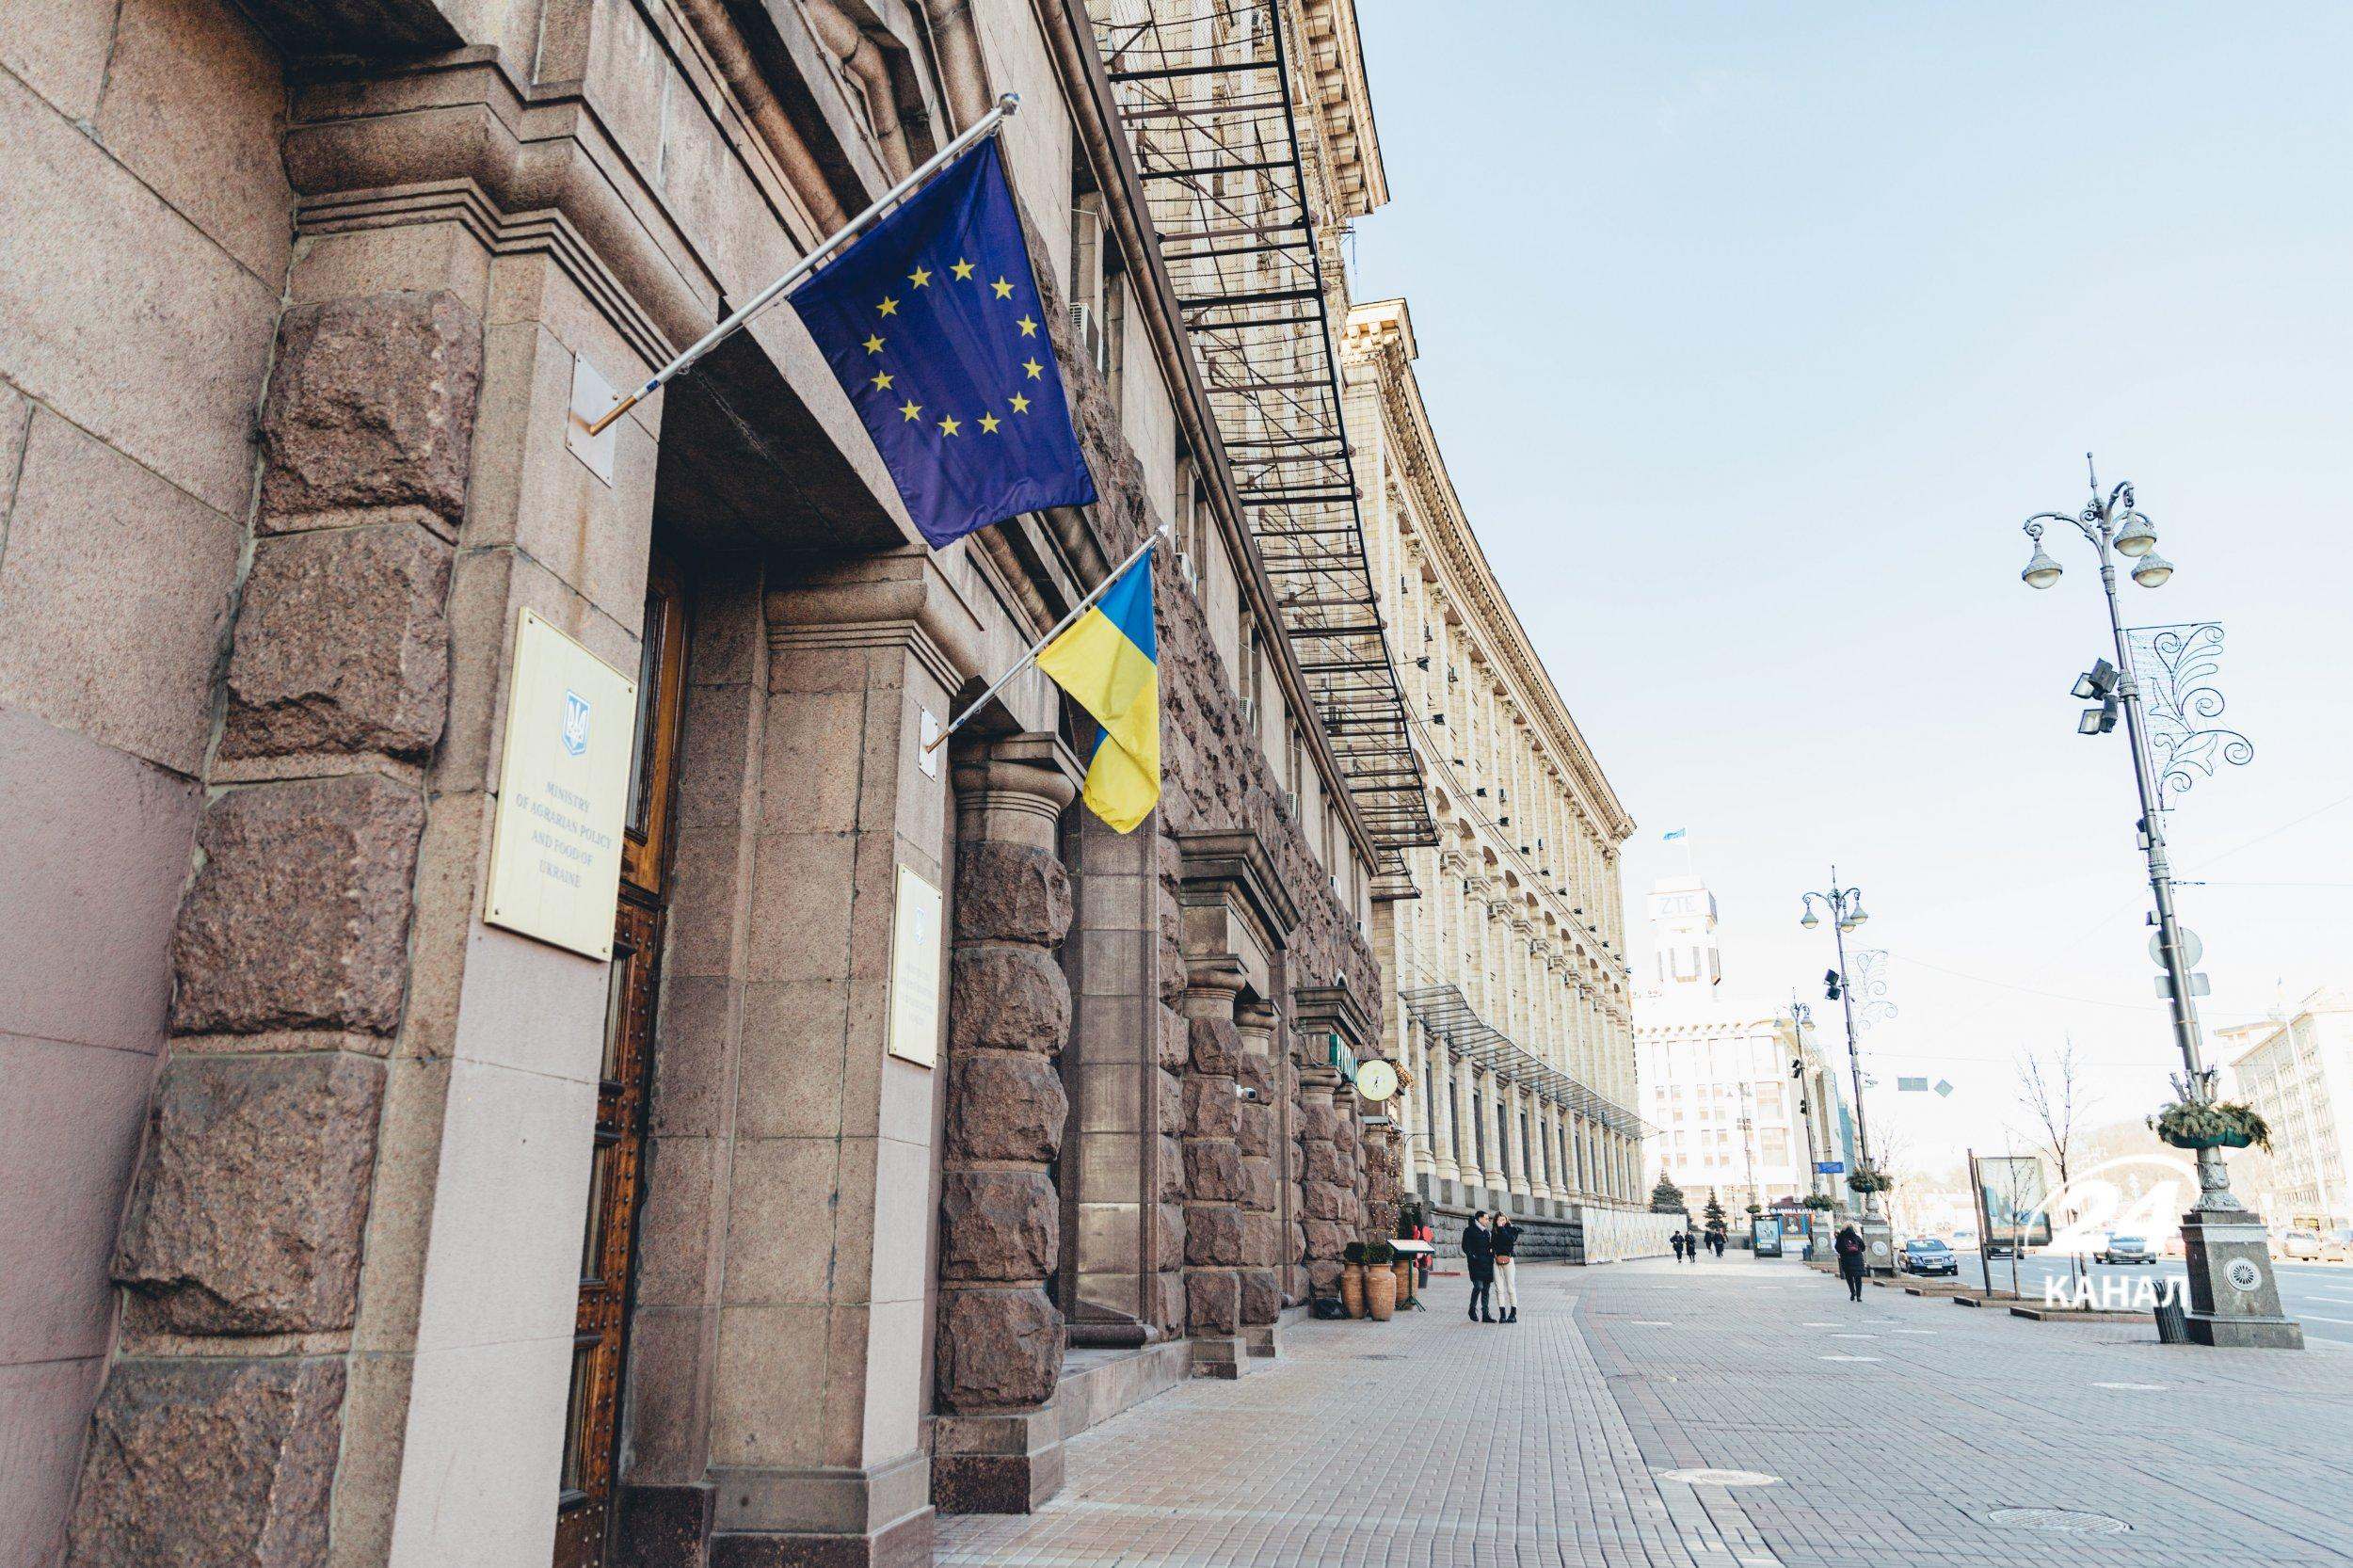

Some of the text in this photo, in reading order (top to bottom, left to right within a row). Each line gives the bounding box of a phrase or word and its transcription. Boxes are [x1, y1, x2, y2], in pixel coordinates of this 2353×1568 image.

[546, 781, 590, 812] MINISTRY
[516, 793, 612, 850] OF AGRARIAN POLICY
[532, 829, 594, 866] AND FOOD OF
[539, 859, 581, 888] UKRAINE
[1657, 894, 1696, 915] ZTE
